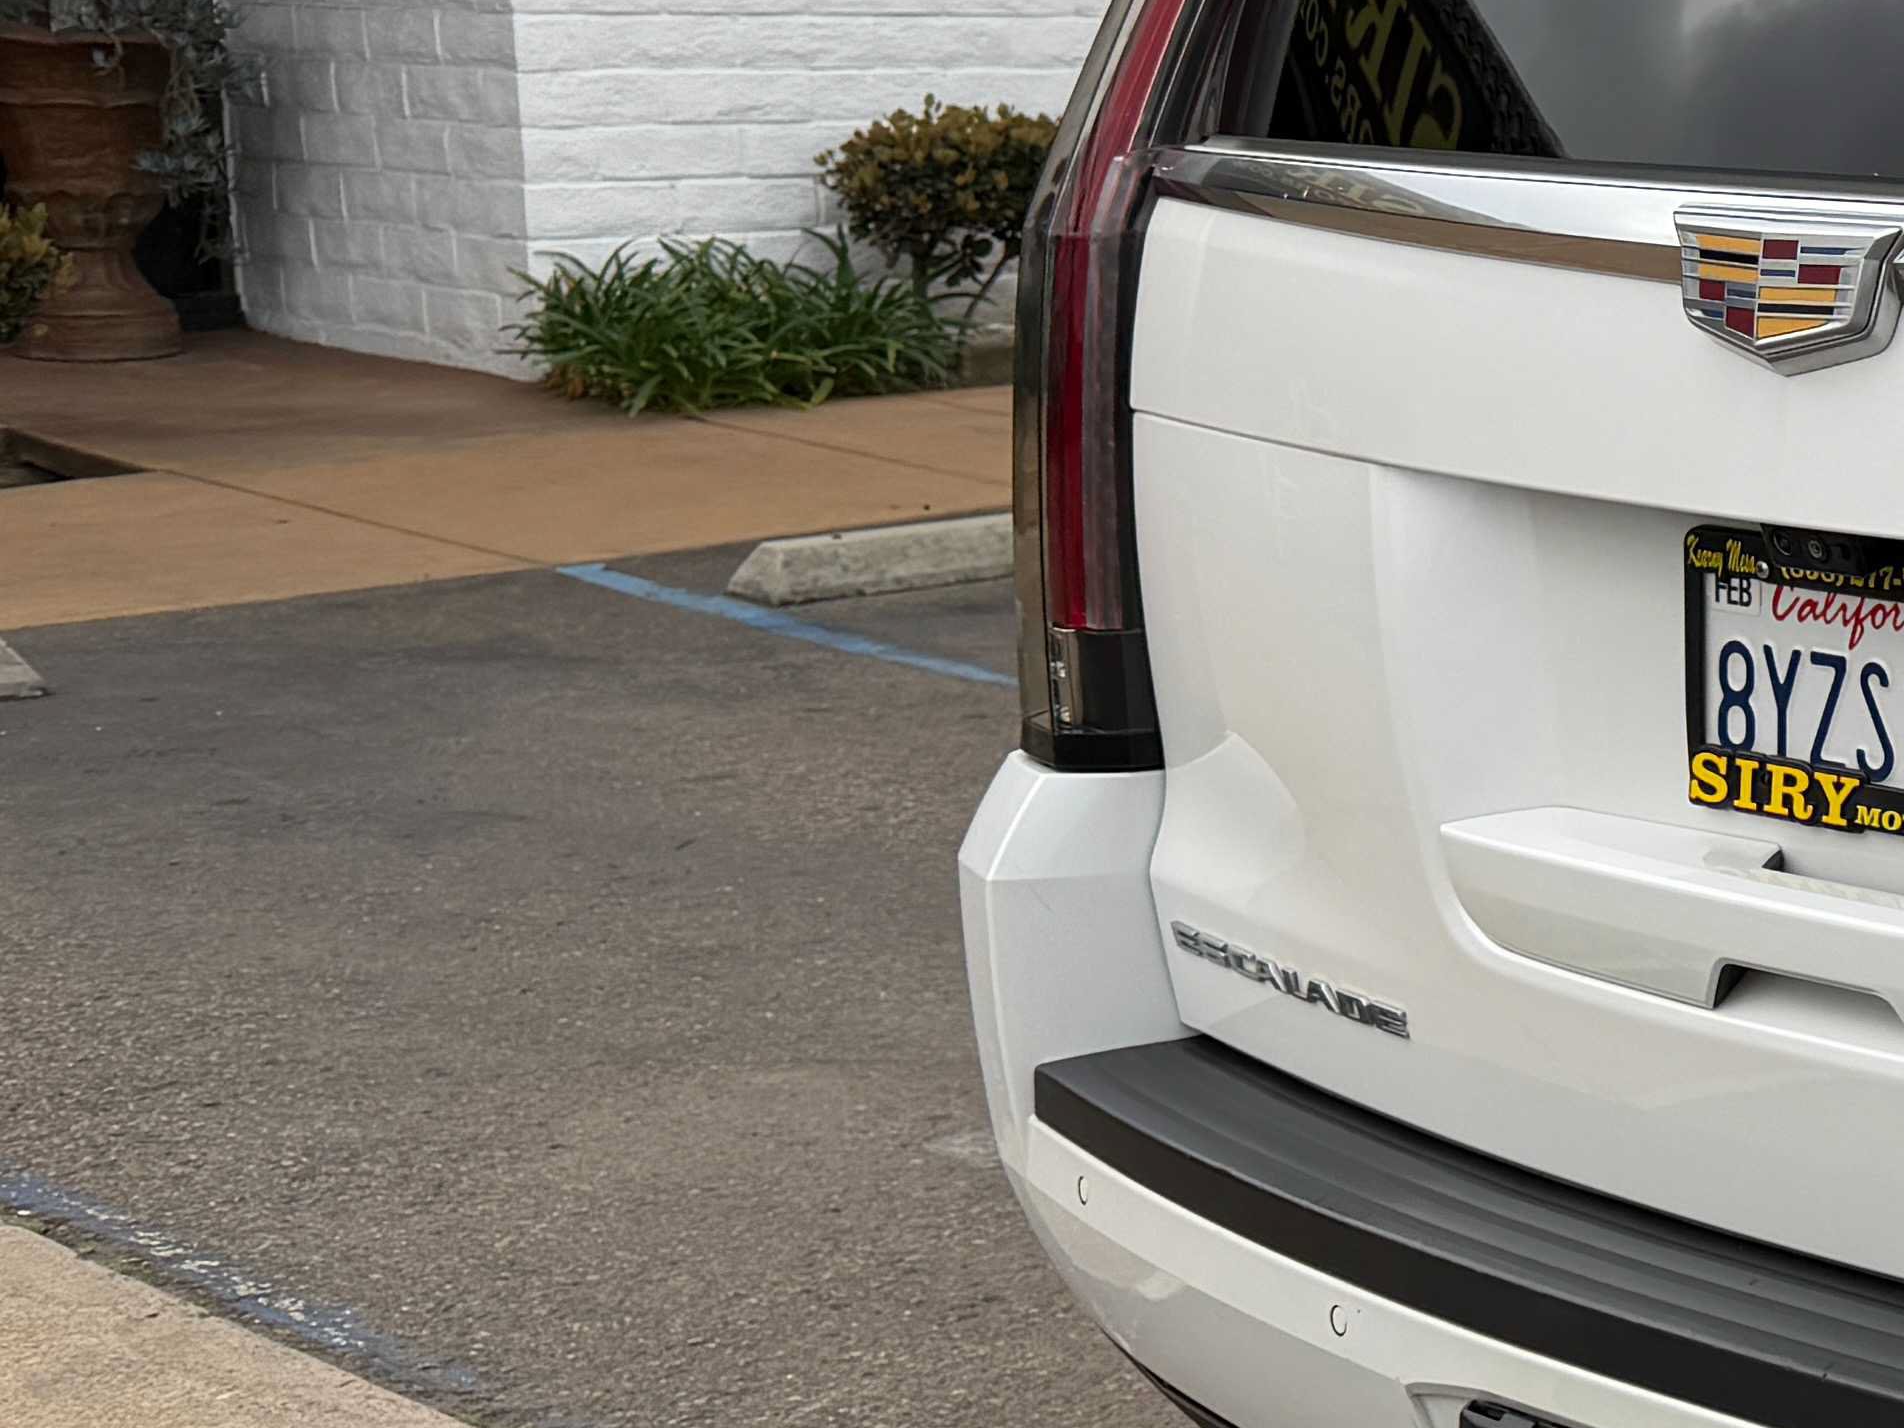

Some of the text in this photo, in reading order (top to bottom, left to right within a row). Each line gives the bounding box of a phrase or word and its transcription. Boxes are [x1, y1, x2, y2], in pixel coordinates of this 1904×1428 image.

[1715, 577, 1753, 607] FEB
[1689, 752, 1861, 827] SIRY
[1171, 919, 1411, 1039] ESCALADE
